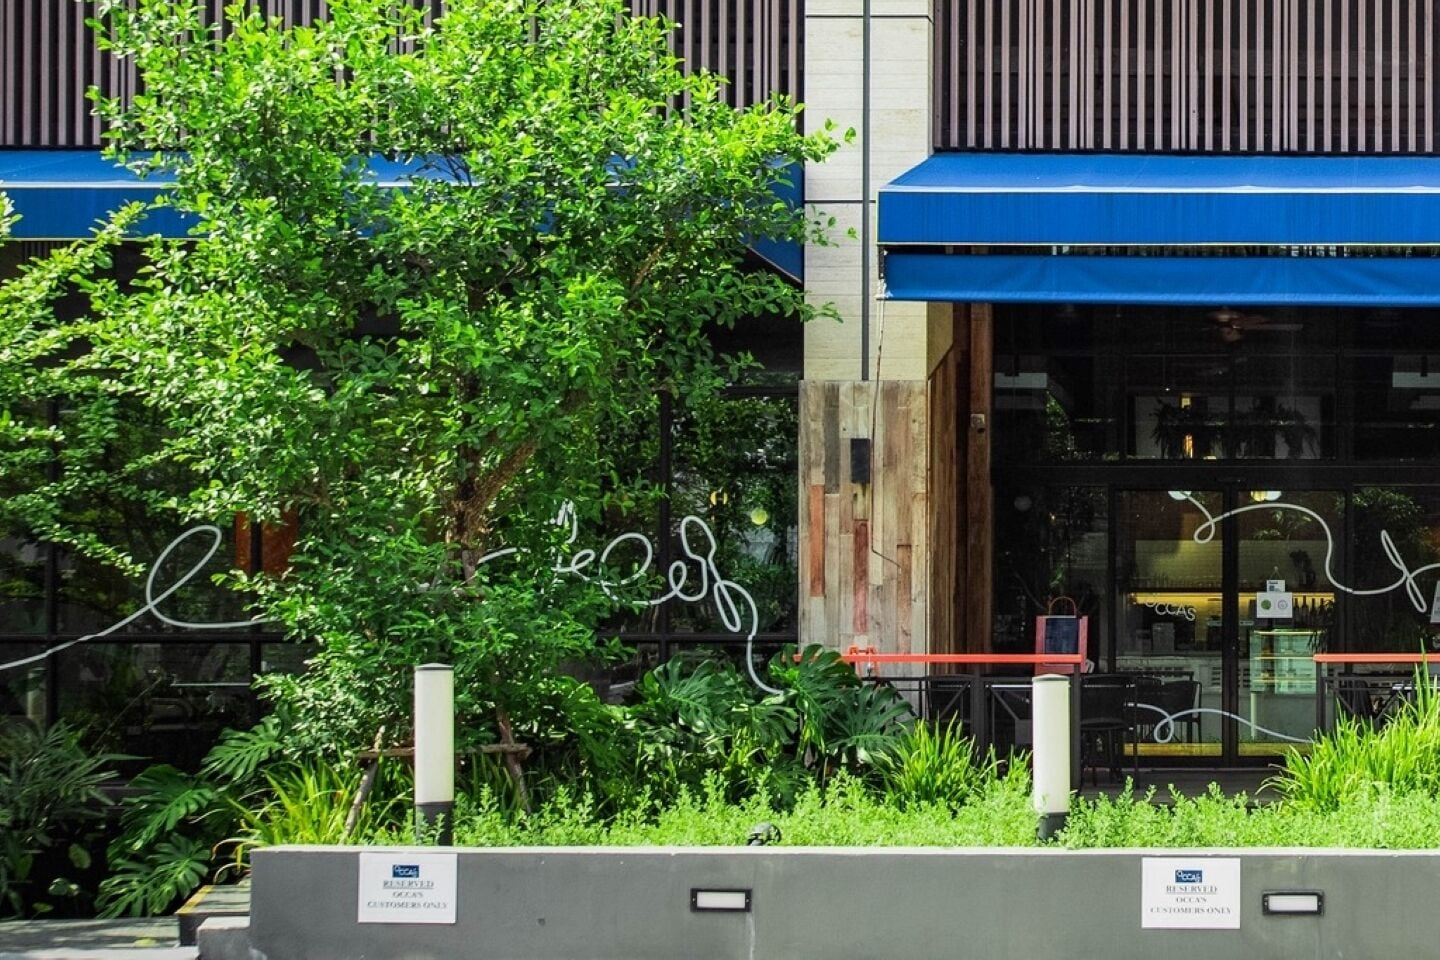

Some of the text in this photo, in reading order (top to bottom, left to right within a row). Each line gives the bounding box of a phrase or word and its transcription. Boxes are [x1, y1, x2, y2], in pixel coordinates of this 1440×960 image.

[383, 879, 434, 888] RESERVED
[1166, 885, 1218, 893] RESERVED
[367, 900, 448, 909] CUSTOMERS ONLY
